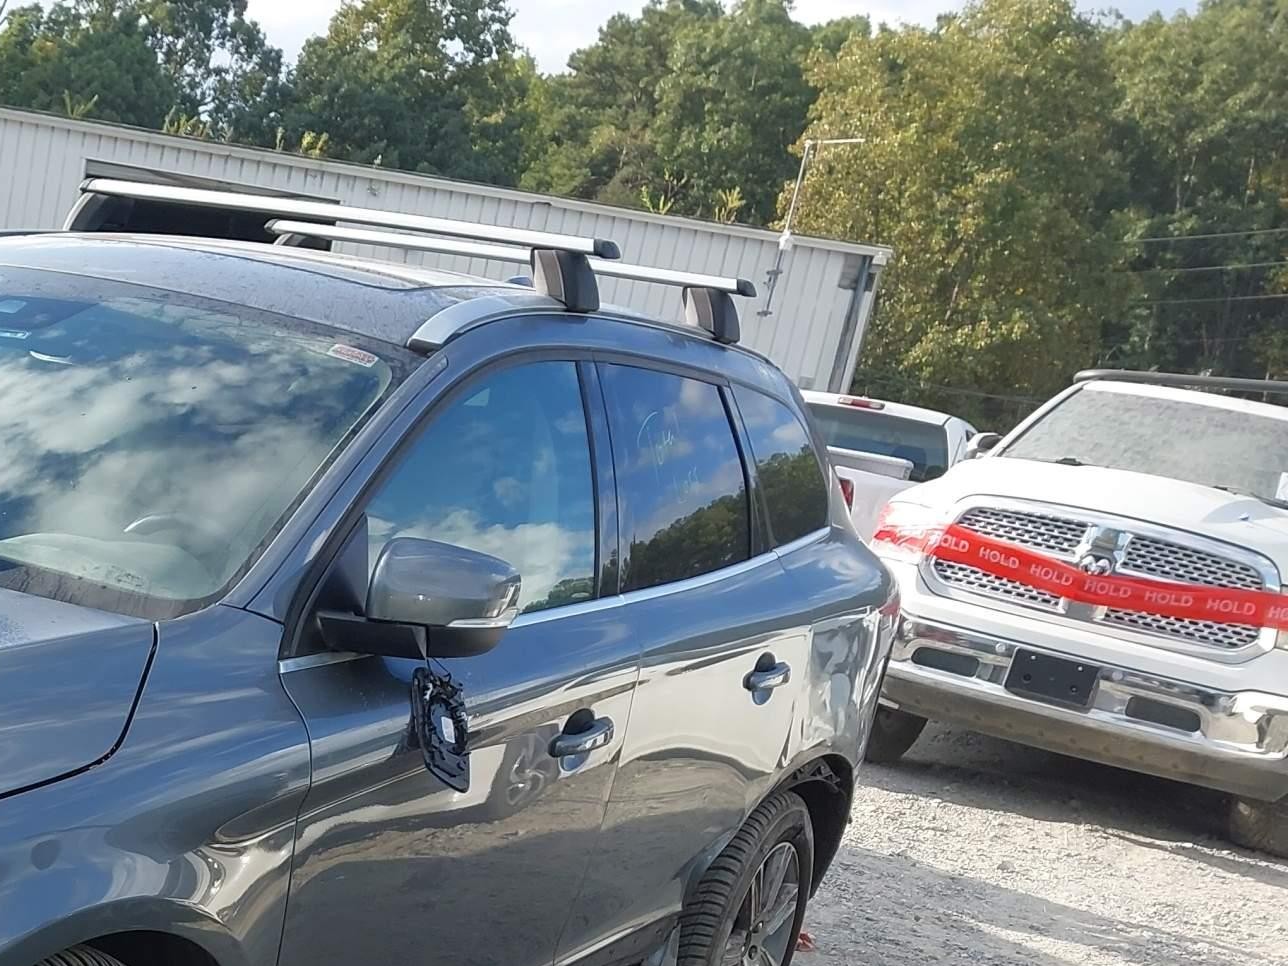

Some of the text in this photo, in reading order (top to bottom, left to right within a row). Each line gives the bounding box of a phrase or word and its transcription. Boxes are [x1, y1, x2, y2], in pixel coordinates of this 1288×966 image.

[979, 546, 1019, 569] HOLD
[1030, 564, 1073, 586] HOLD
[1084, 579, 1131, 598] HOLD
[1144, 591, 1193, 607] HOLD
[1206, 599, 1256, 616] HOLD
